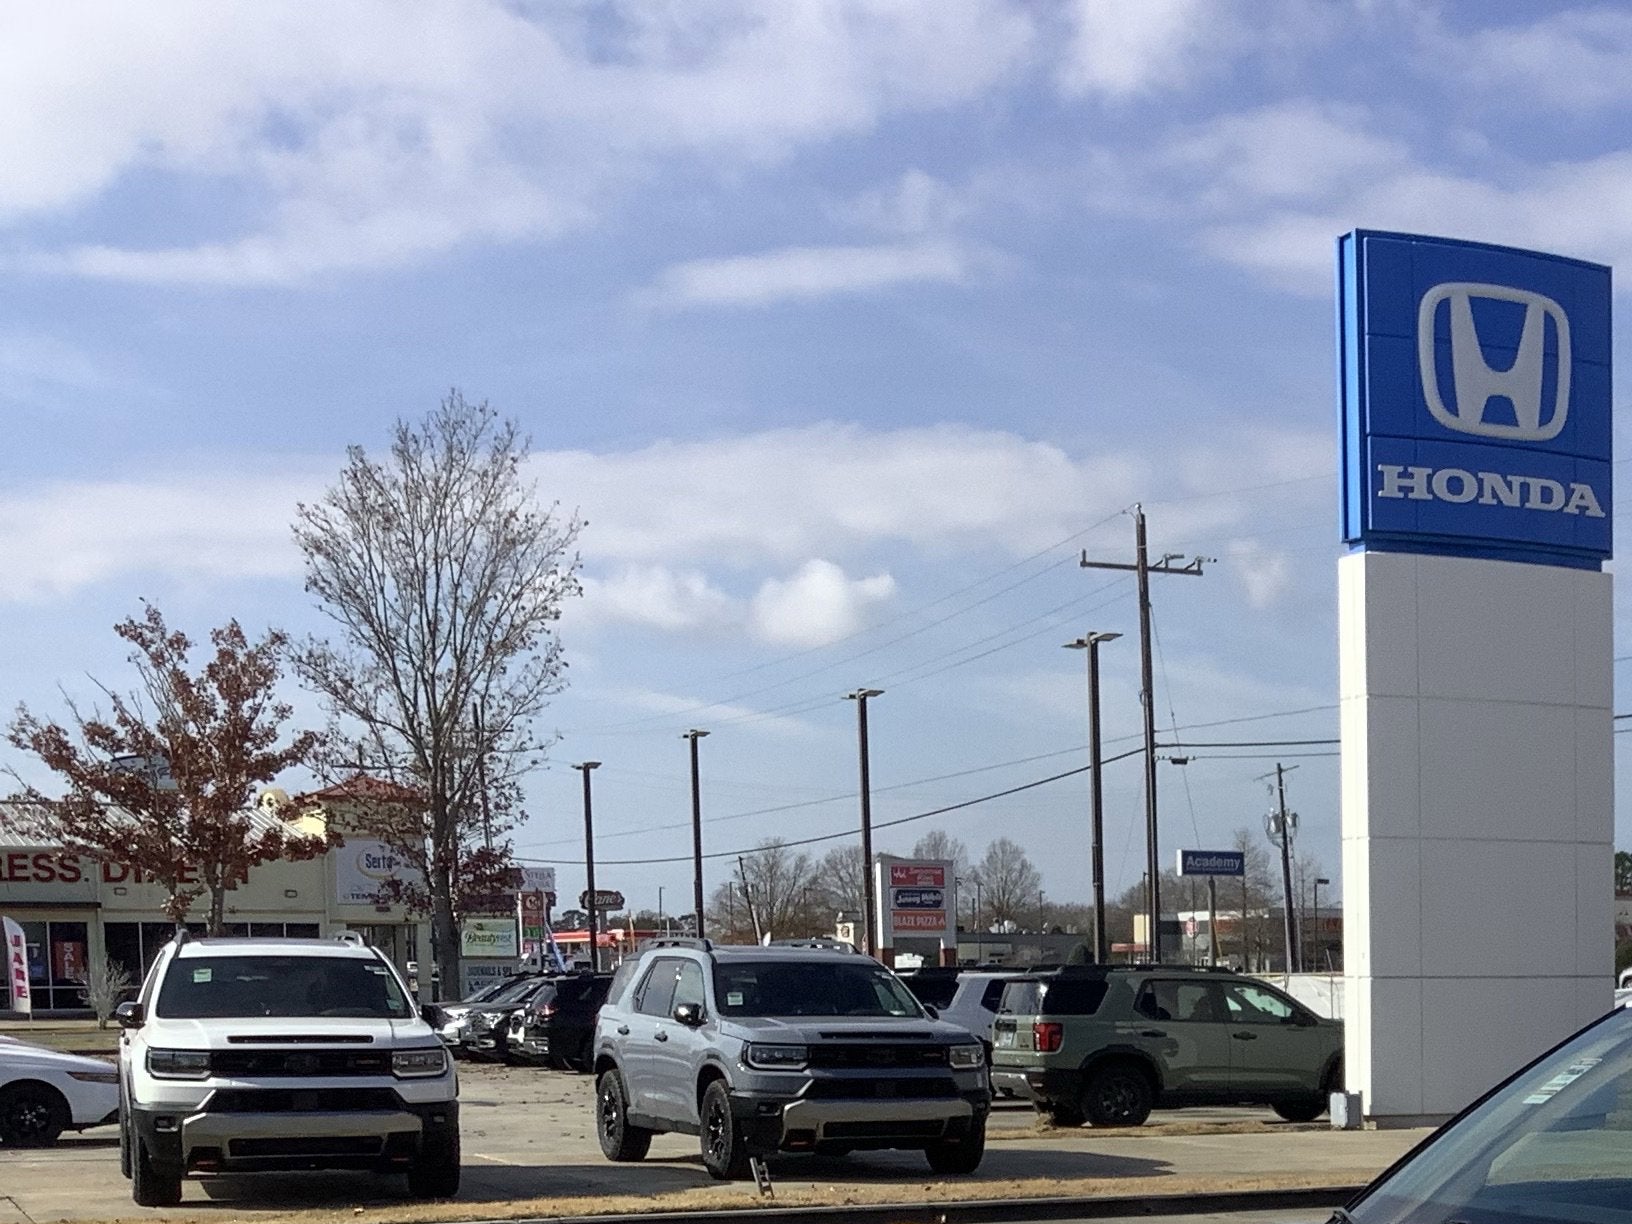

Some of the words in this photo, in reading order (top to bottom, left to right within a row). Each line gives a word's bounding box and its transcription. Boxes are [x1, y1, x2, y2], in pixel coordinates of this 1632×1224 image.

[1377, 464, 1606, 518] HONDA
[0, 852, 82, 884] ESS
[1186, 855, 1240, 870] Academy
